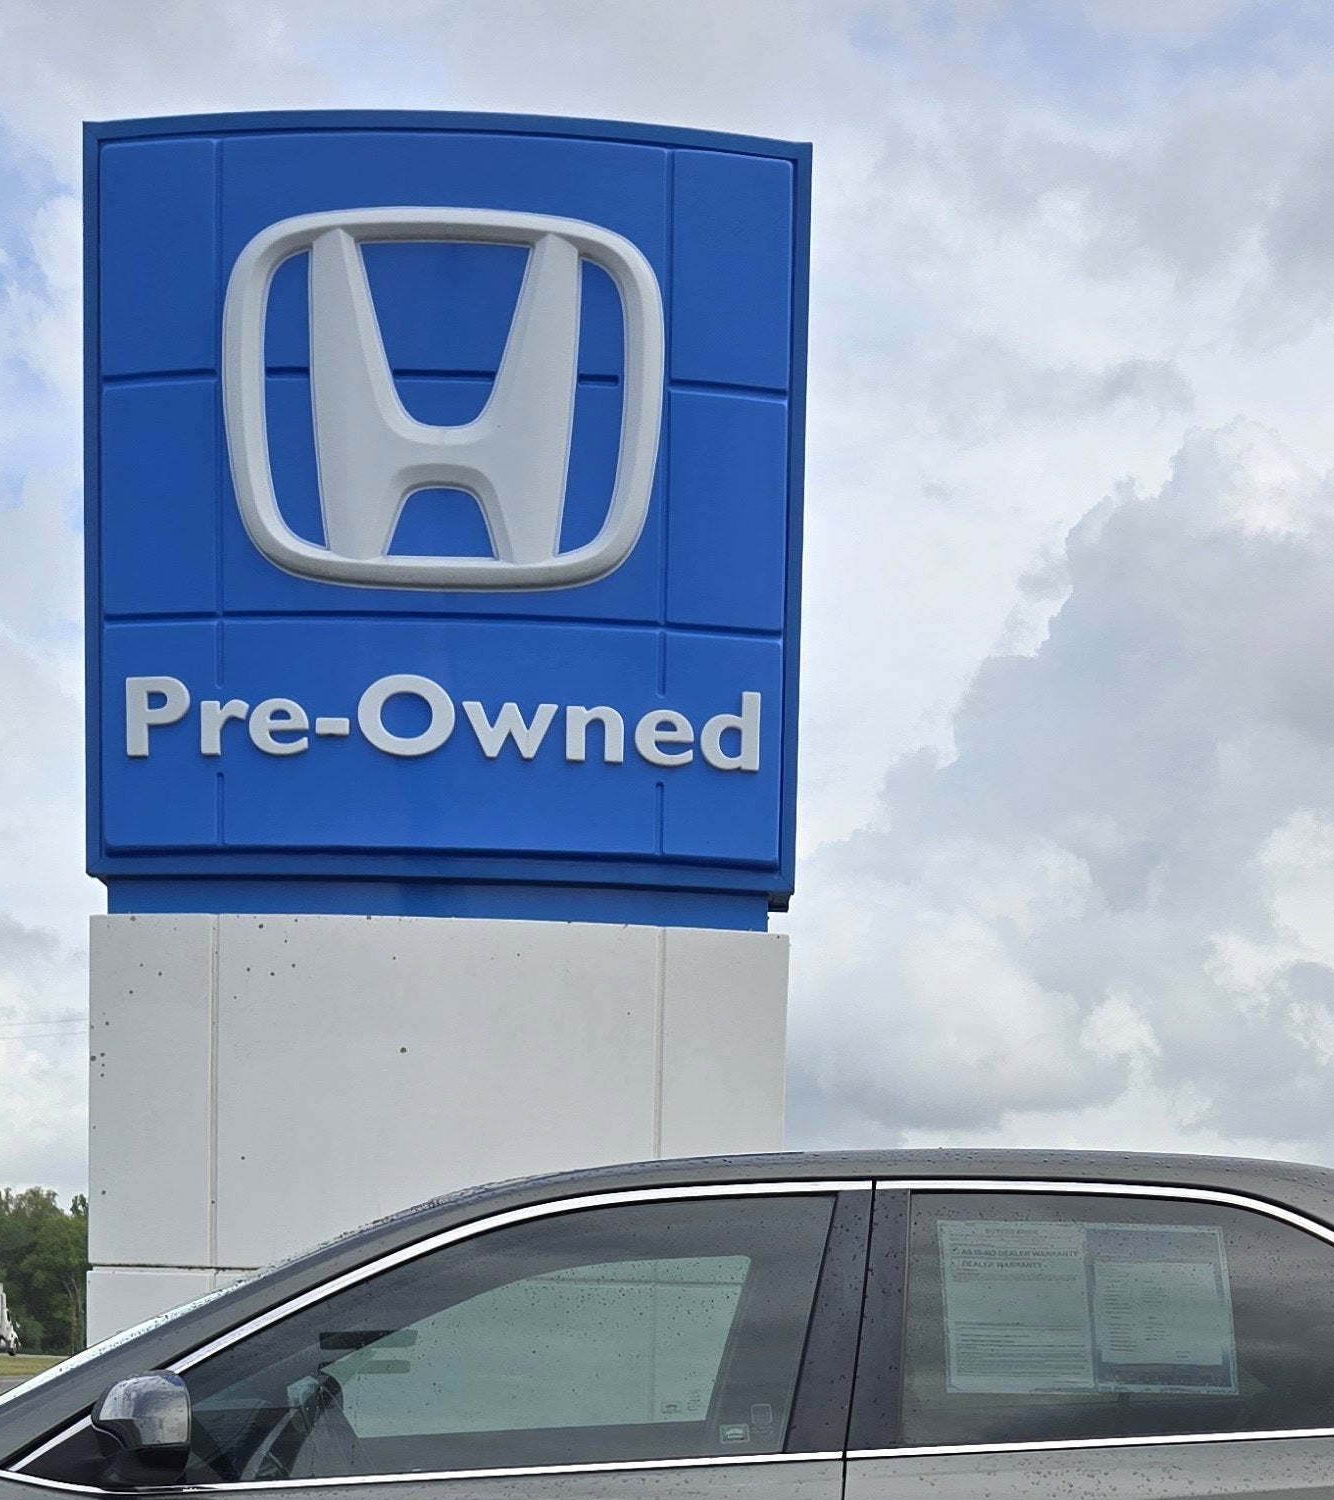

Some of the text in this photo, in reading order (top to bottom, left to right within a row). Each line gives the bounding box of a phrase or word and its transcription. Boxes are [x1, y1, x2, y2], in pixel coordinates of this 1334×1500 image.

[125, 674, 761, 772] Pre-Owned
[998, 1249, 1032, 1257] DEALER
[1033, 1249, 1079, 1257] WARRANTY
[962, 1260, 1043, 1269] DEALER WARRANTY
